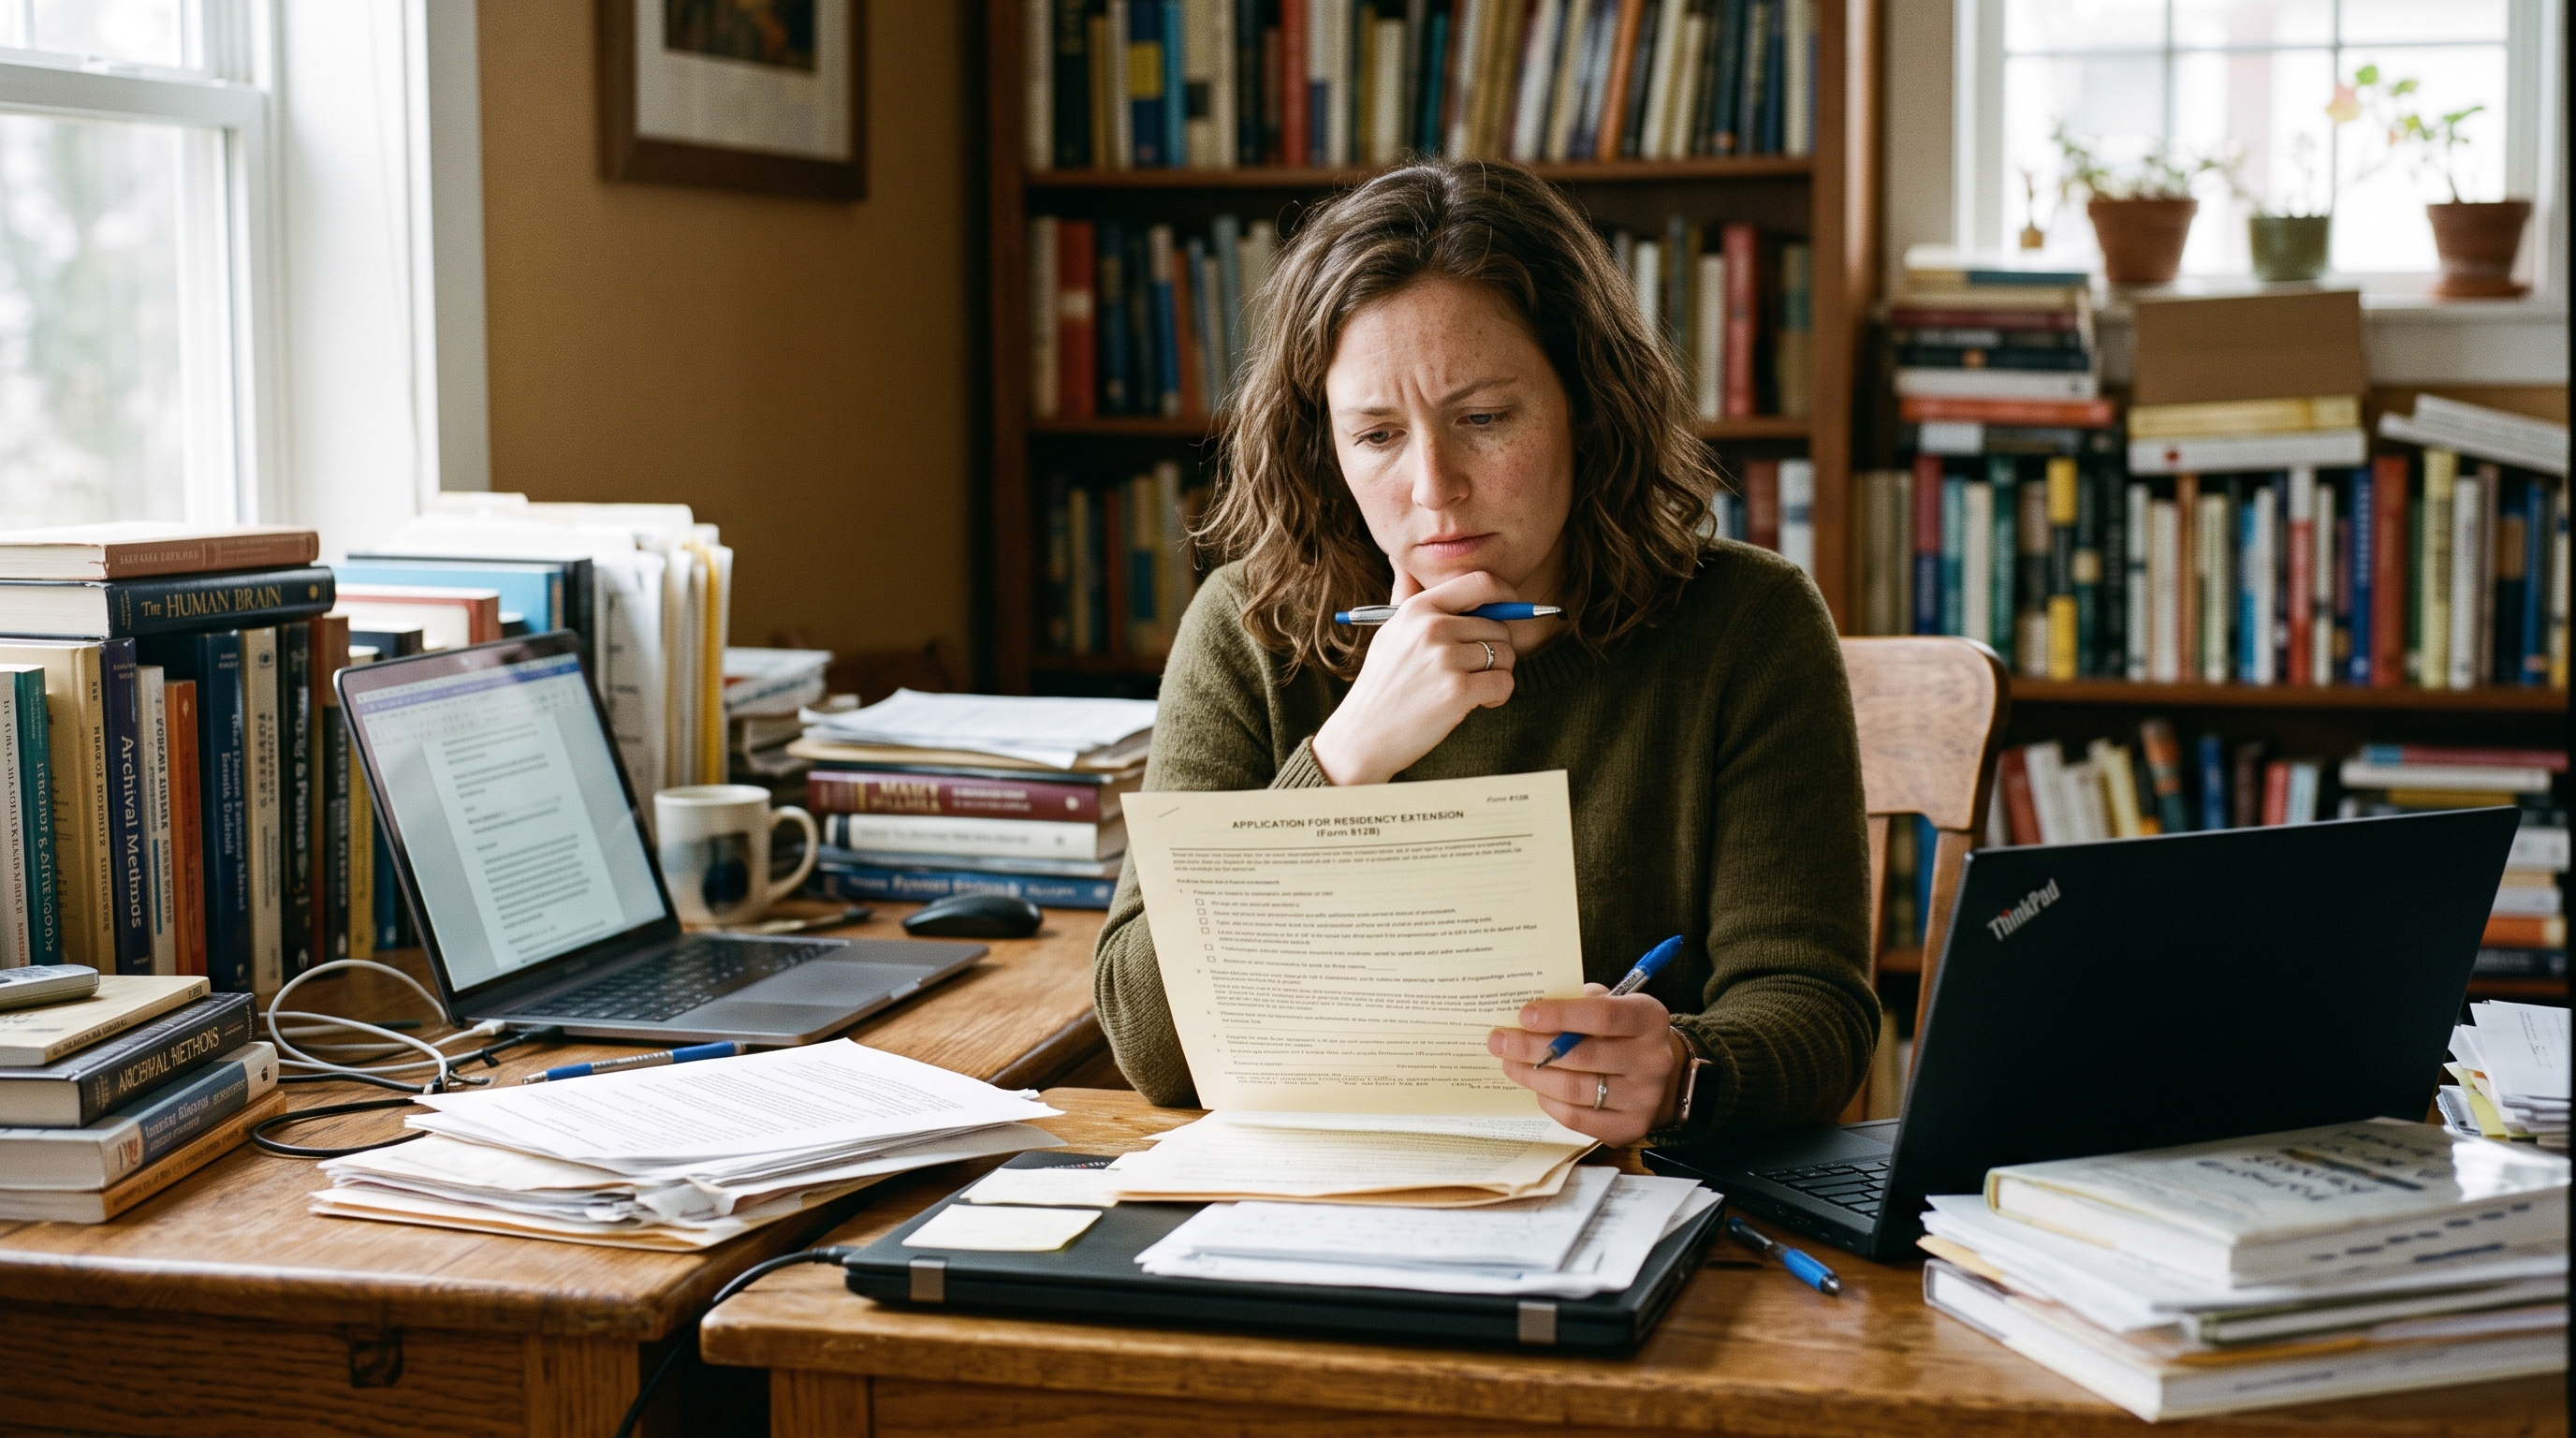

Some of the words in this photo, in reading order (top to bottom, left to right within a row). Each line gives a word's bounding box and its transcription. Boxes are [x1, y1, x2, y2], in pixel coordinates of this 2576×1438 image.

[166, 588, 229, 618] HUMAN
[234, 583, 282, 611] BRAIN
[121, 736, 139, 828] Archival
[1232, 818, 1306, 829] APPLICATION
[1308, 816, 1331, 828] FOR
[1334, 814, 1398, 826] RESIDENCY
[1400, 810, 1464, 824] EXTENSION
[1350, 826, 1381, 837] 812B)
[1985, 876, 2061, 942] ThinkPad
